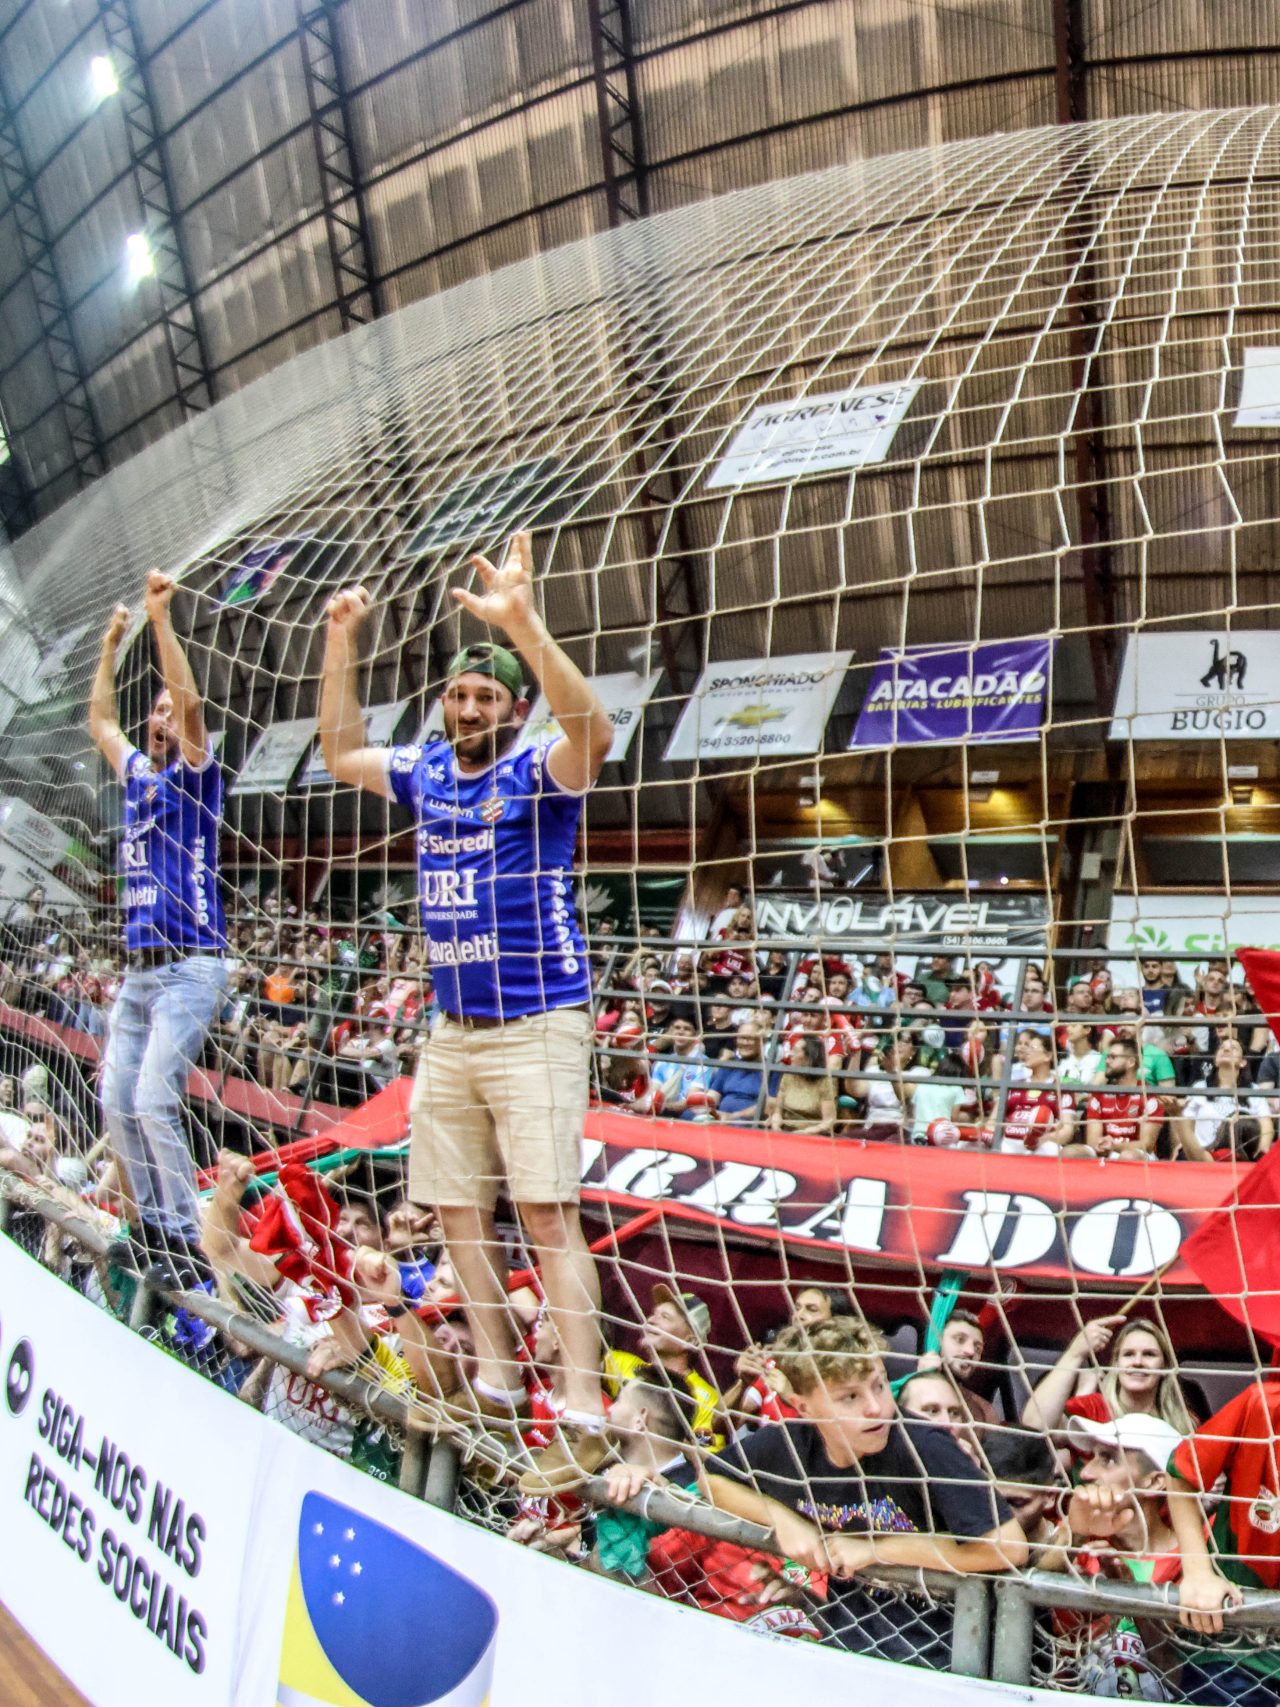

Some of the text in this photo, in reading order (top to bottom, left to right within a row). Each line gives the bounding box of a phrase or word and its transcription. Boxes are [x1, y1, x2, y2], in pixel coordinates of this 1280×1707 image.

[870, 670, 1047, 702] ATACADÃO
[1170, 709, 1267, 731] BUGIO
[122, 840, 149, 869] RI
[429, 829, 495, 854] Sicredi
[423, 868, 479, 908] URI
[427, 931, 500, 965] avaletti
[936, 1190, 1182, 1276] DO
[38, 1387, 208, 1579] SIGA-NOS NAS
[24, 1451, 209, 1676] REDES SOCIAIS
